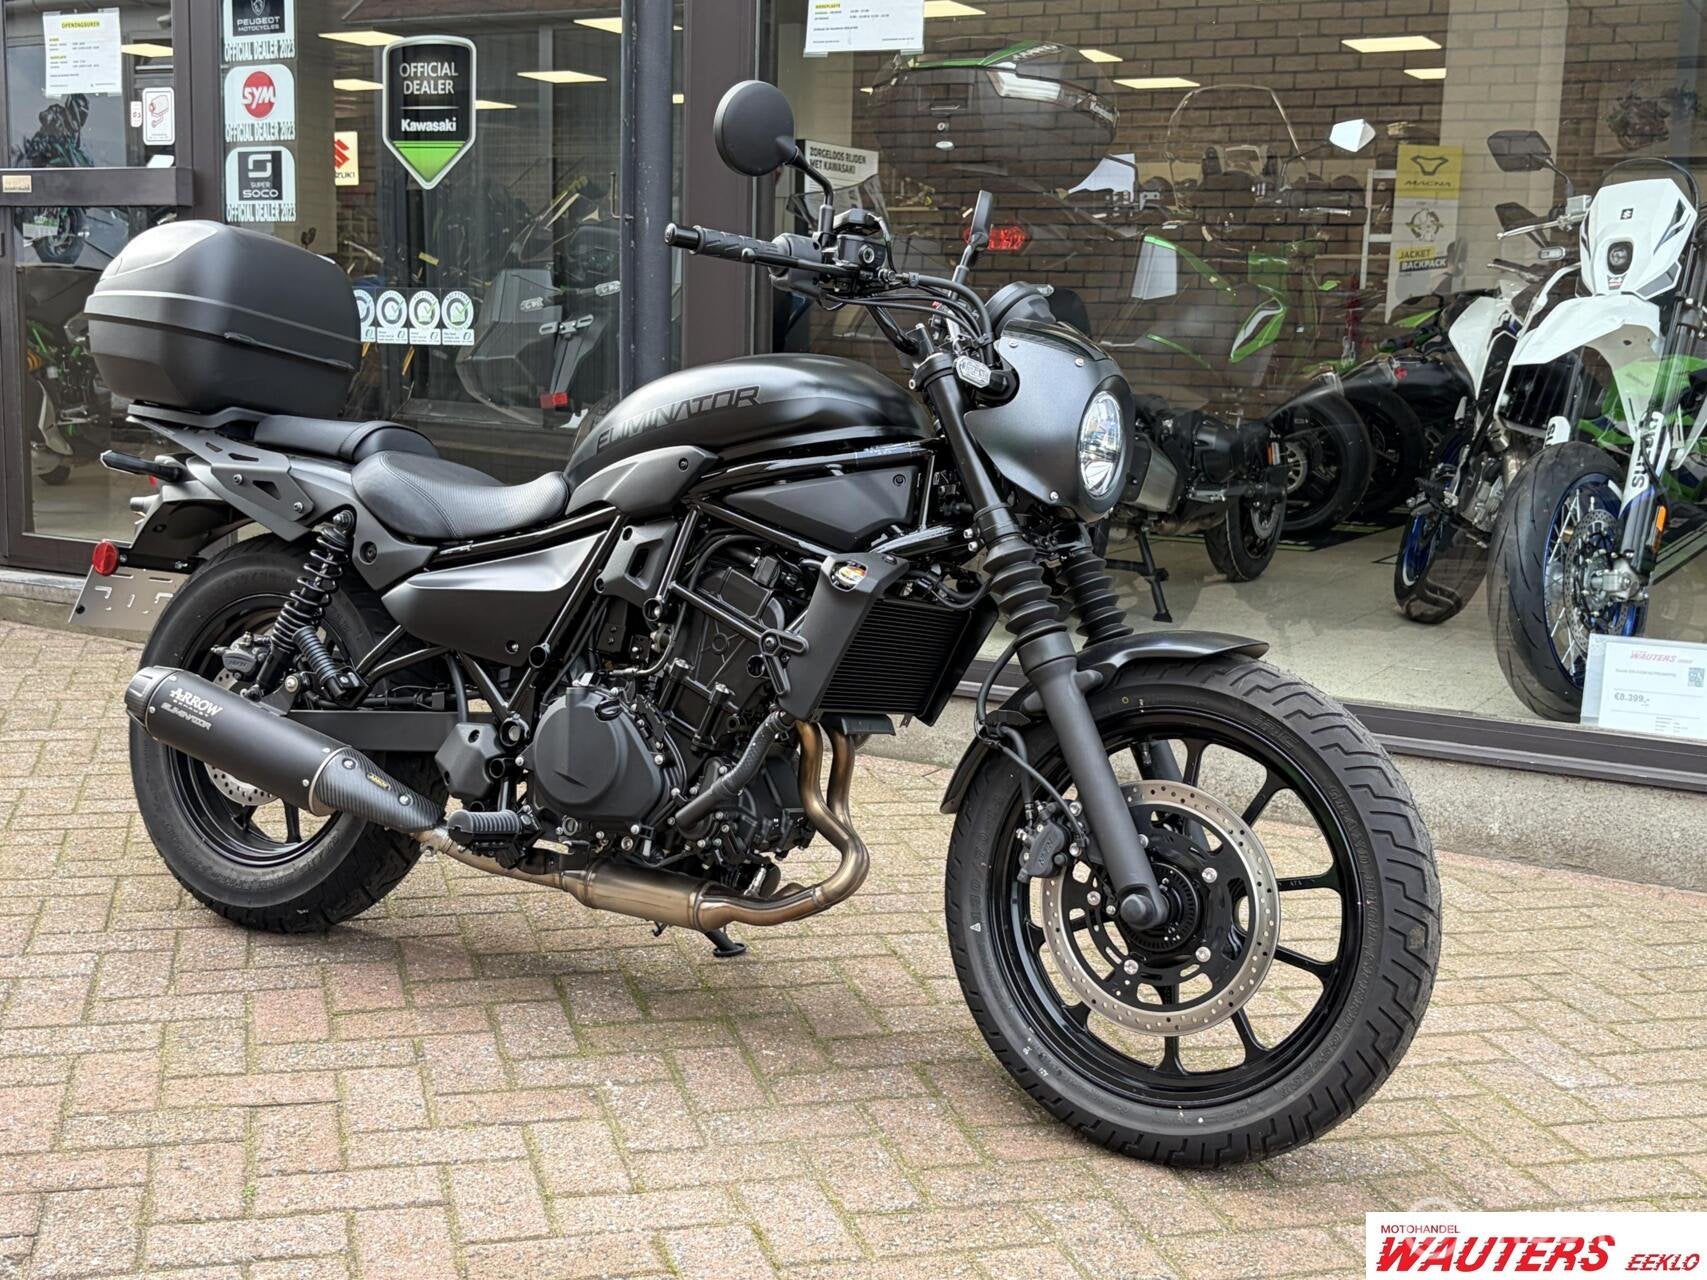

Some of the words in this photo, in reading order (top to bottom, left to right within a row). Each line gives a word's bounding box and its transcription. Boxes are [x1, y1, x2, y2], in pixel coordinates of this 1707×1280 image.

[237, 16, 280, 25] PEUGEOT
[225, 41, 252, 62] OFFICIAL
[253, 40, 278, 60] DEALER
[399, 62, 459, 78] OFFICIAL
[403, 80, 454, 95] DEALER
[242, 86, 276, 109] SYM
[225, 122, 253, 142] OFFICIAL
[254, 122, 279, 141] DEALER
[401, 117, 457, 132] Kawasaki
[242, 189, 279, 198] SOCO
[226, 203, 254, 223] OFFICIAL
[255, 203, 280, 222] DEALER
[1399, 248, 1431, 259] JACKET
[1401, 258, 1447, 271] BACKPACK
[596, 385, 761, 456] ELIMINATOR
[169, 687, 223, 716] ARROW
